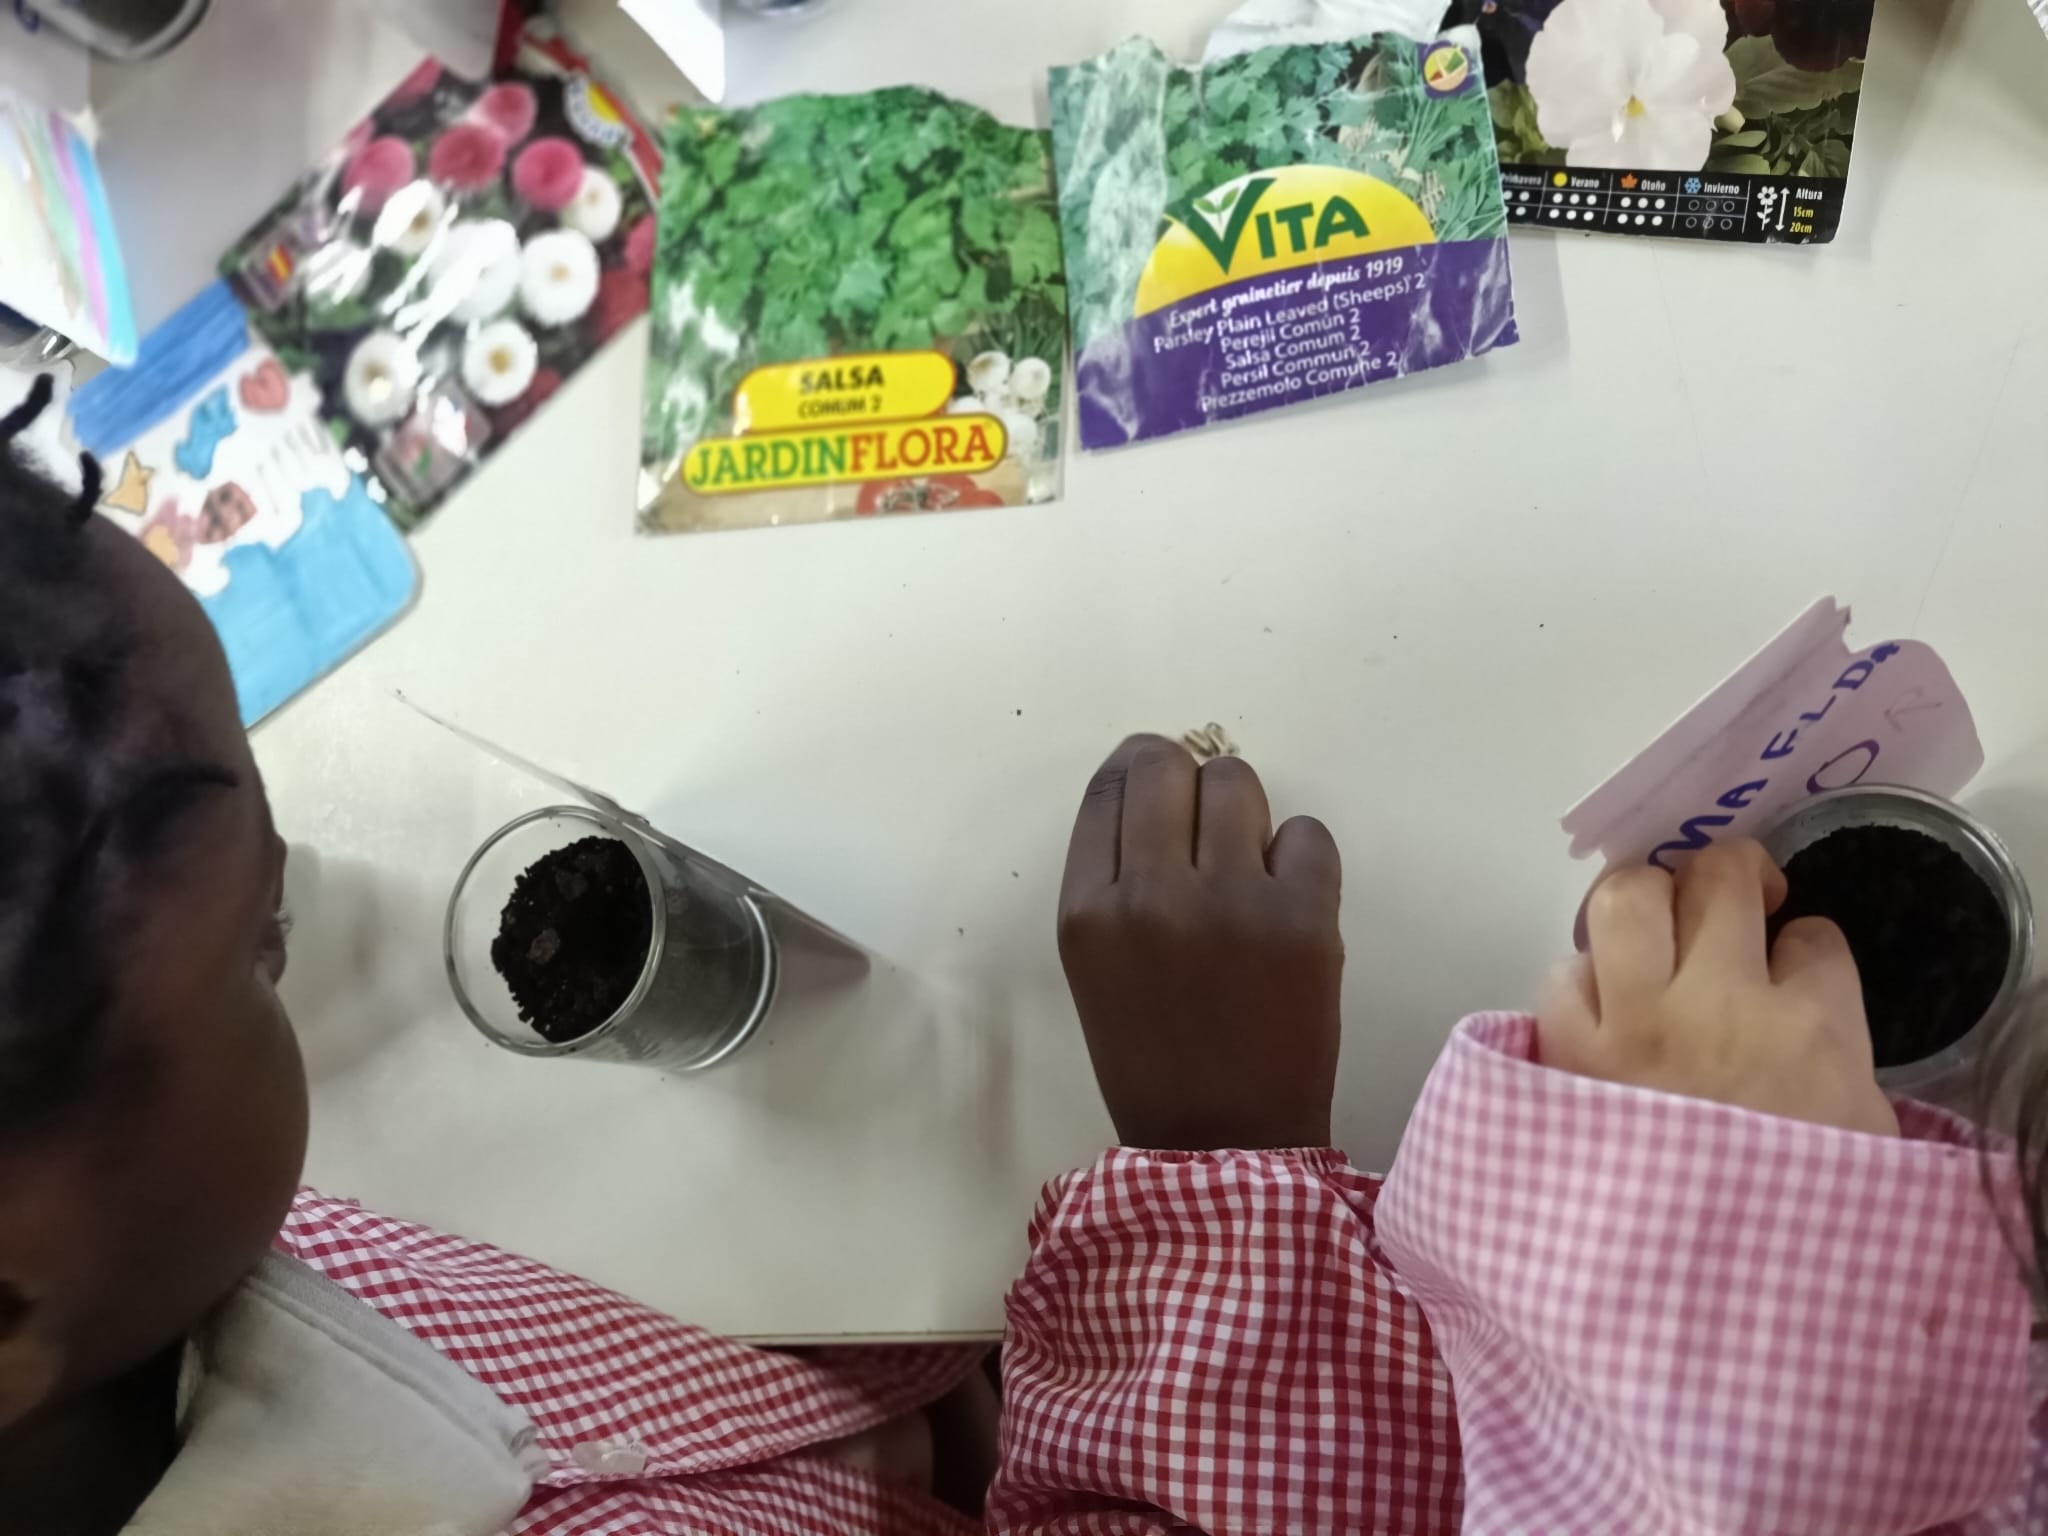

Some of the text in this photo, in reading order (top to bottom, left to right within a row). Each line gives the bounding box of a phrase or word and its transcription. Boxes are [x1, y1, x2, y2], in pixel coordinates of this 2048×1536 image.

[1571, 176, 1600, 188] Verano
[1641, 179, 1666, 191] Otoño
[1704, 182, 1740, 195] Invierno
[1795, 187, 1823, 201] Altura
[1163, 177, 1370, 275] VITA
[1789, 222, 1813, 234] 20cm
[1793, 206, 1814, 218] 15cm
[1169, 256, 1403, 329] Expert grainetier depuis 1919
[1153, 325, 1214, 354] Parsley
[1217, 314, 1262, 337] Plain
[1265, 296, 1329, 326] Leaved
[1414, 272, 1426, 289] 2
[1220, 326, 1276, 354] Perejil
[1349, 307, 1361, 323] 2
[1221, 340, 1371, 389] Persil Commun 2
[1225, 325, 1362, 370] Salsa Comum 2
[800, 364, 884, 395] SALSA
[1201, 351, 1398, 413] Prezzemolo Comune 2
[798, 396, 882, 419] COMUM 2
[690, 424, 995, 487] JARDINFLORA
